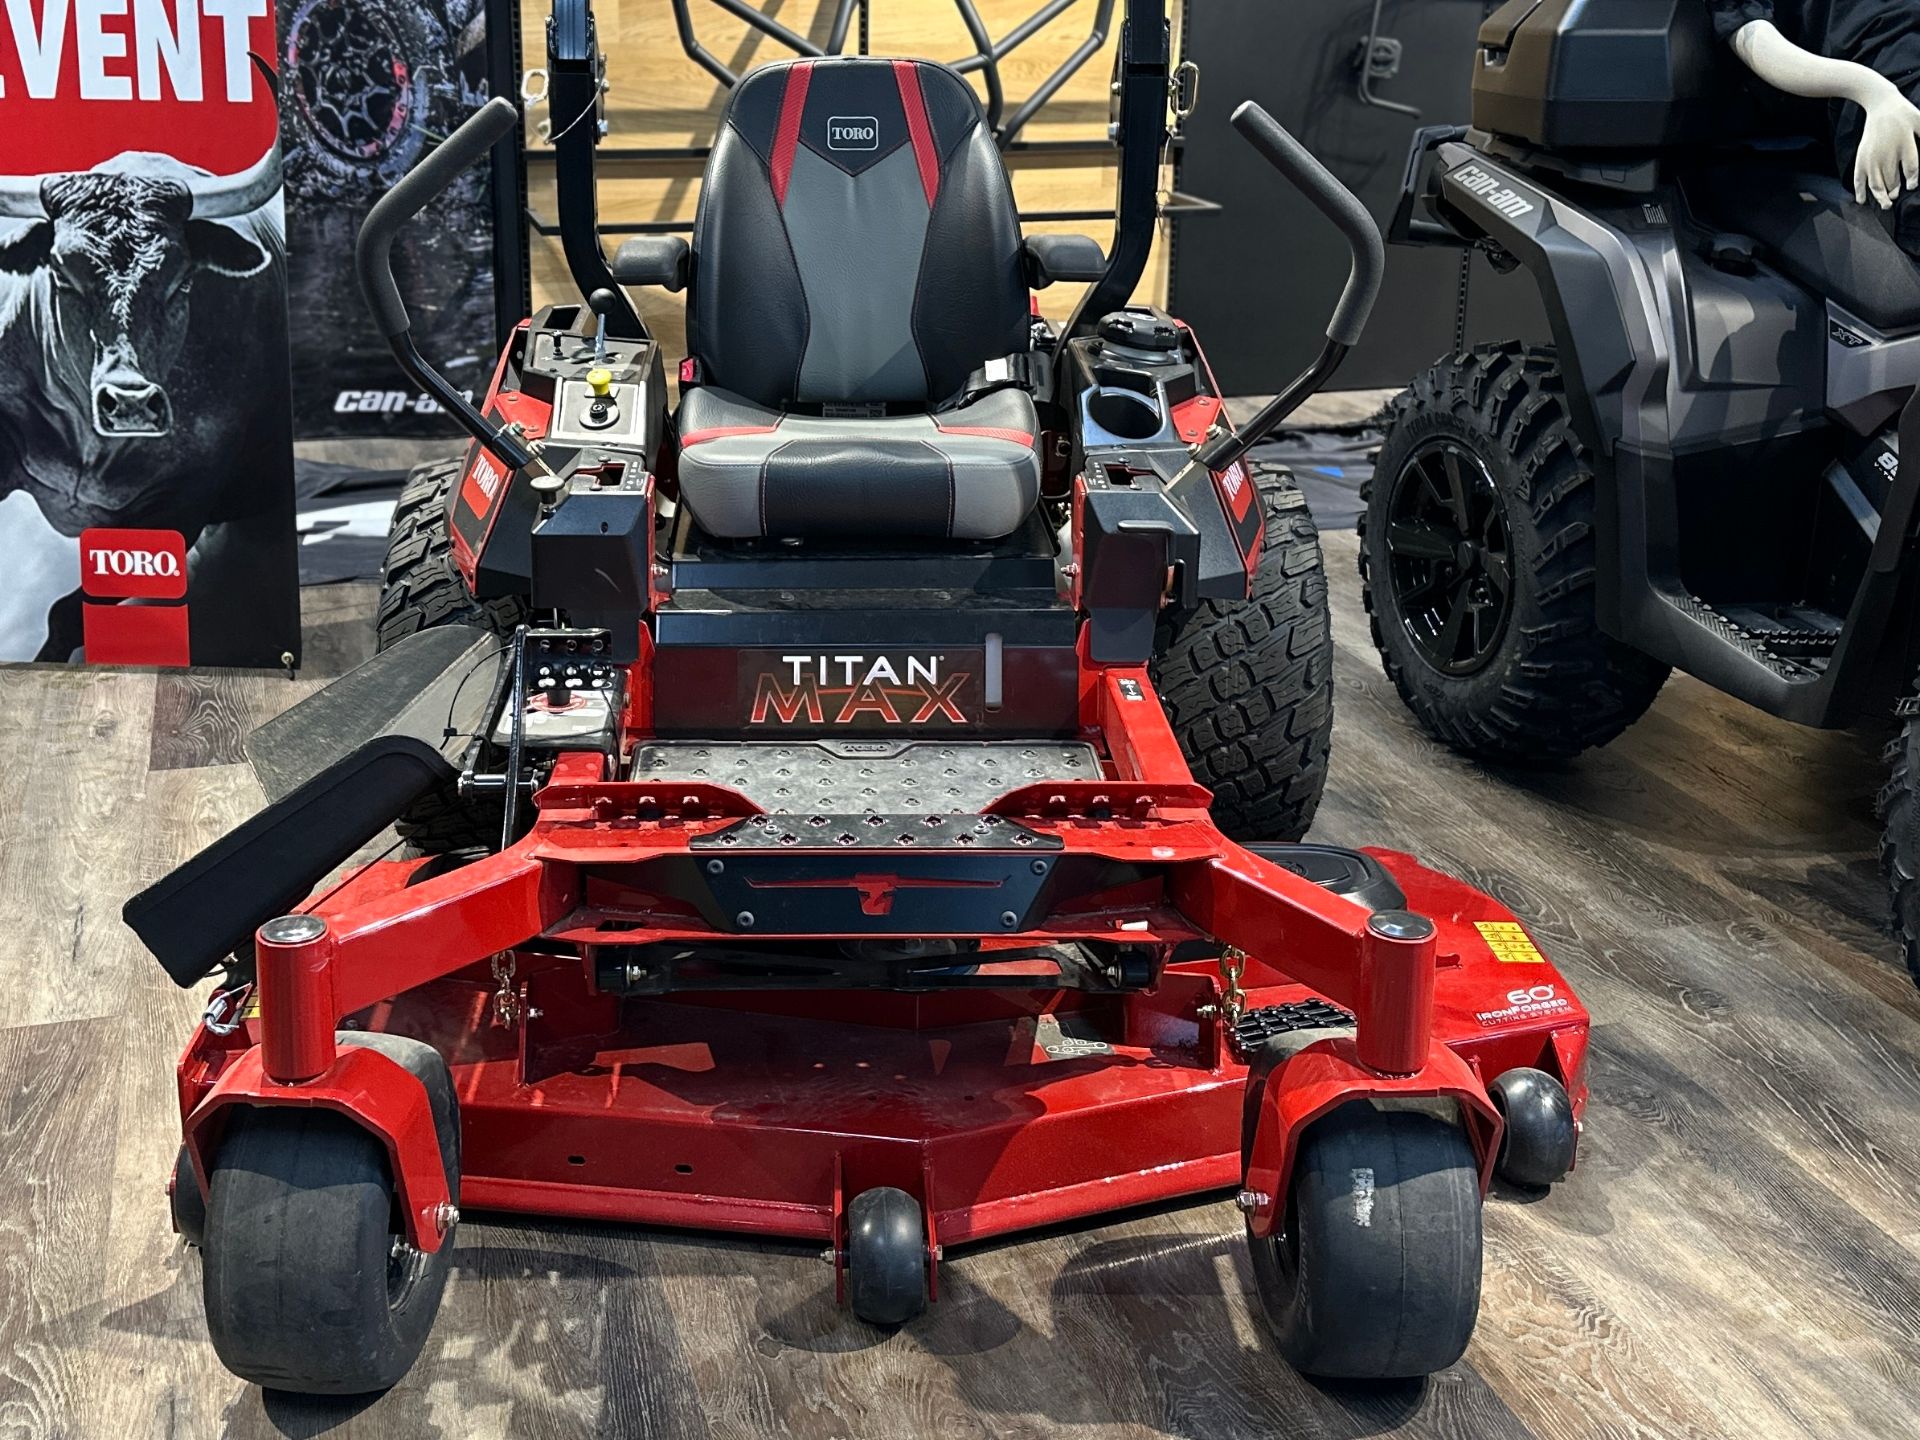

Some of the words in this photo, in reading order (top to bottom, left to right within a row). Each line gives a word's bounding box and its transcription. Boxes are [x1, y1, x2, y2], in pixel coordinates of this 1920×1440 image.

[0, 0, 267, 102] VENT
[831, 127, 874, 140] TORO
[1453, 165, 1534, 218] can-am
[1832, 327, 1863, 345] XT
[750, 673, 970, 723] MAX
